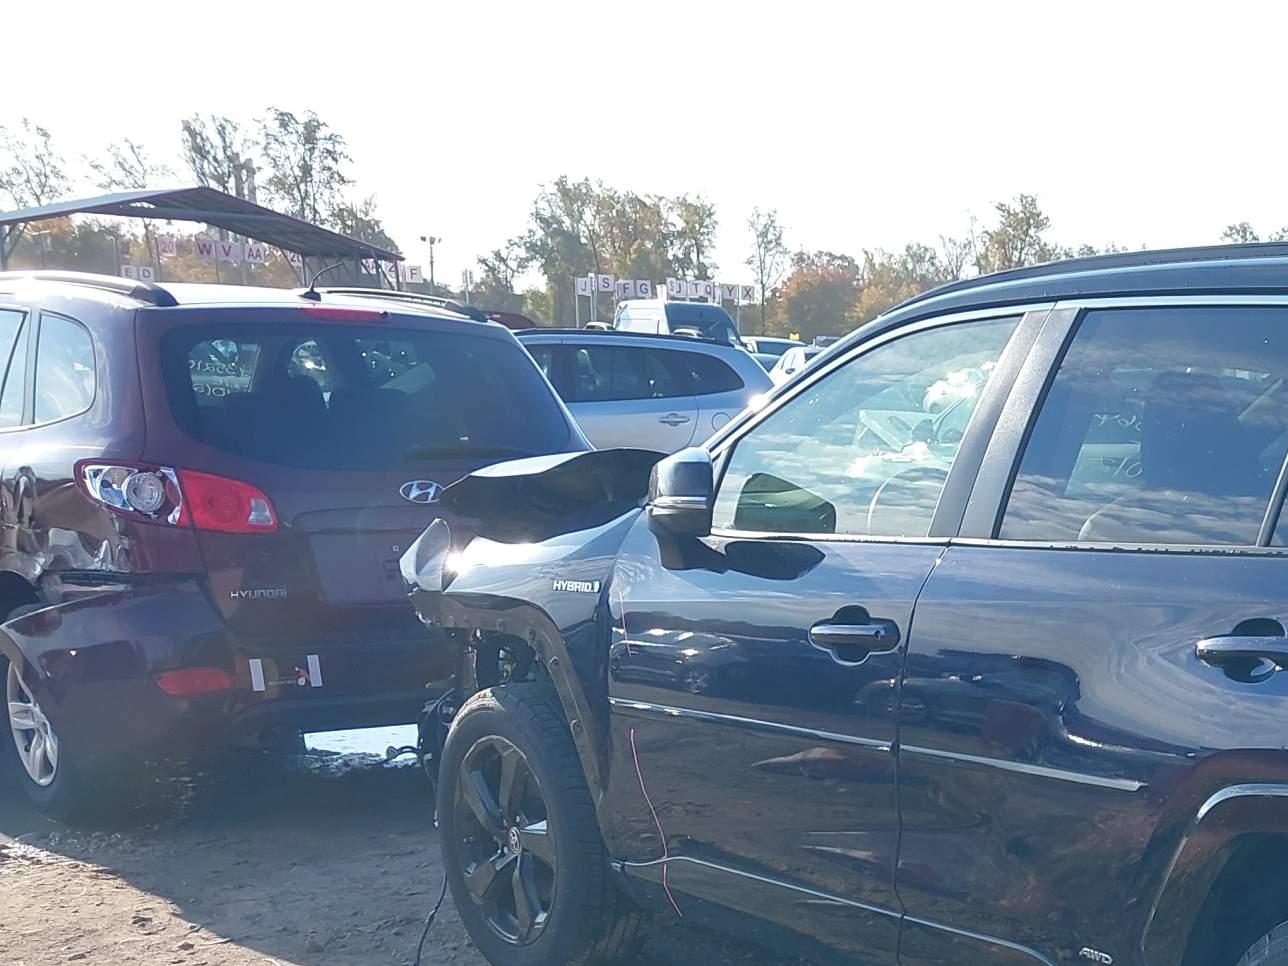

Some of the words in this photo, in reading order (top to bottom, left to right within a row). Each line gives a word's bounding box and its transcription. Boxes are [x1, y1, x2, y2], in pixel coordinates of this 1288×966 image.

[196, 242, 213, 256] W
[222, 245, 231, 256] V
[247, 247, 262, 260] AA
[142, 268, 150, 278] D
[410, 268, 417, 279] F
[602, 277, 610, 288] S
[623, 283, 629, 293] F
[692, 283, 699, 293] T
[640, 283, 648, 294] G
[727, 287, 734, 296] Y
[744, 288, 751, 298] X
[553, 580, 592, 592] HYBRID
[231, 589, 288, 599] HYUNDAI
